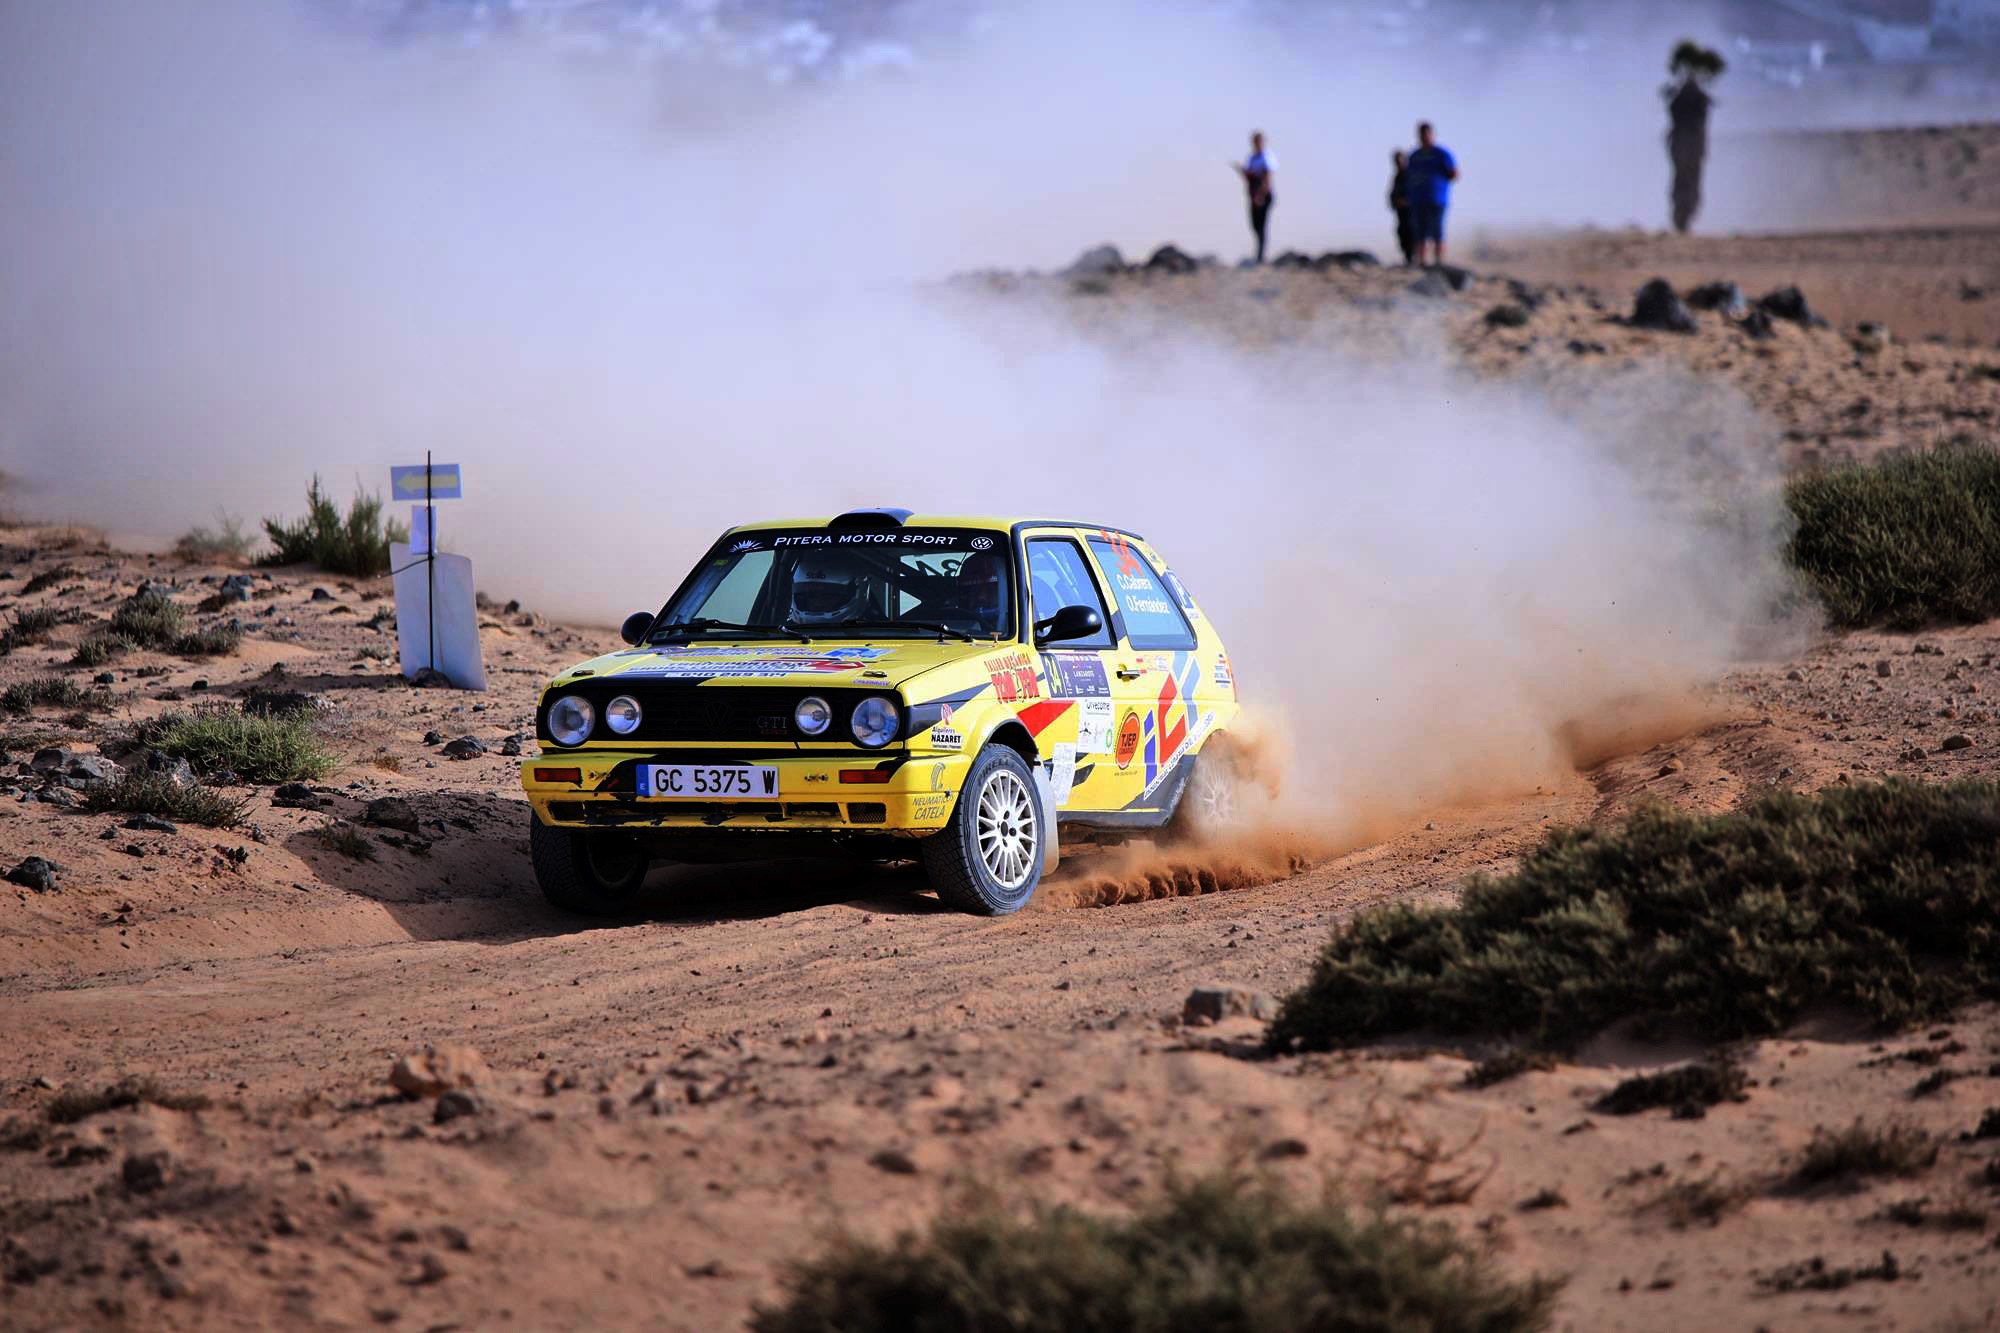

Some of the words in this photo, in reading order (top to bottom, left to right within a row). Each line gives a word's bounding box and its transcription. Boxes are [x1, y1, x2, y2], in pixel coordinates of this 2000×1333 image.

[774, 535, 832, 546] PITERA
[838, 533, 897, 544] MOTOR
[901, 534, 957, 546] SPORT
[1044, 655, 1063, 695] 34
[757, 716, 787, 729] GTI
[931, 734, 962, 744] NAZARET
[655, 768, 683, 793] GC
[694, 769, 751, 794] 5375
[762, 770, 776, 794] W
[914, 805, 945, 820] CATELA
